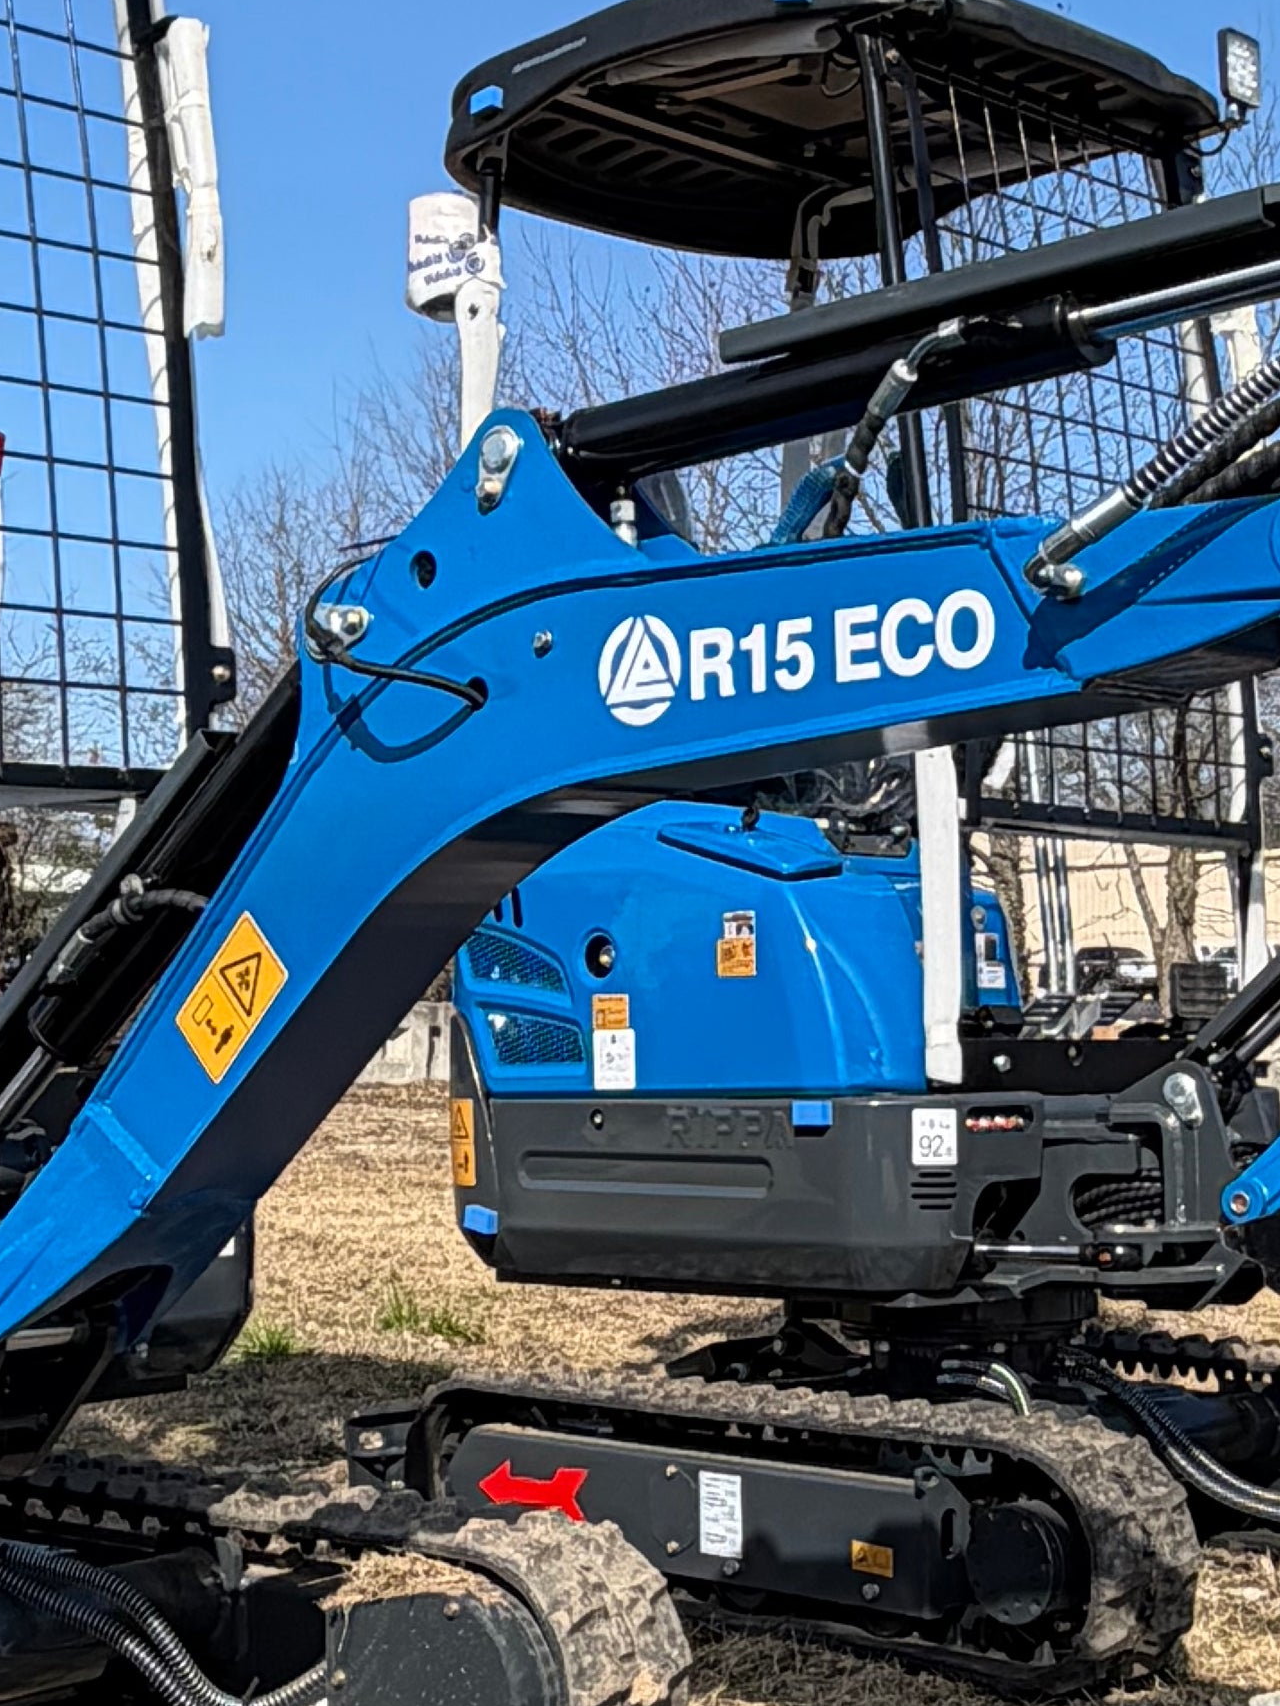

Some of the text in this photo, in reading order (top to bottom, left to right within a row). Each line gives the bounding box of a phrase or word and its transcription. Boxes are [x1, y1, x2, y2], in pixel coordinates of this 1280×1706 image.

[689, 588, 996, 701] R15 ECO
[918, 1134, 944, 1158] 92
